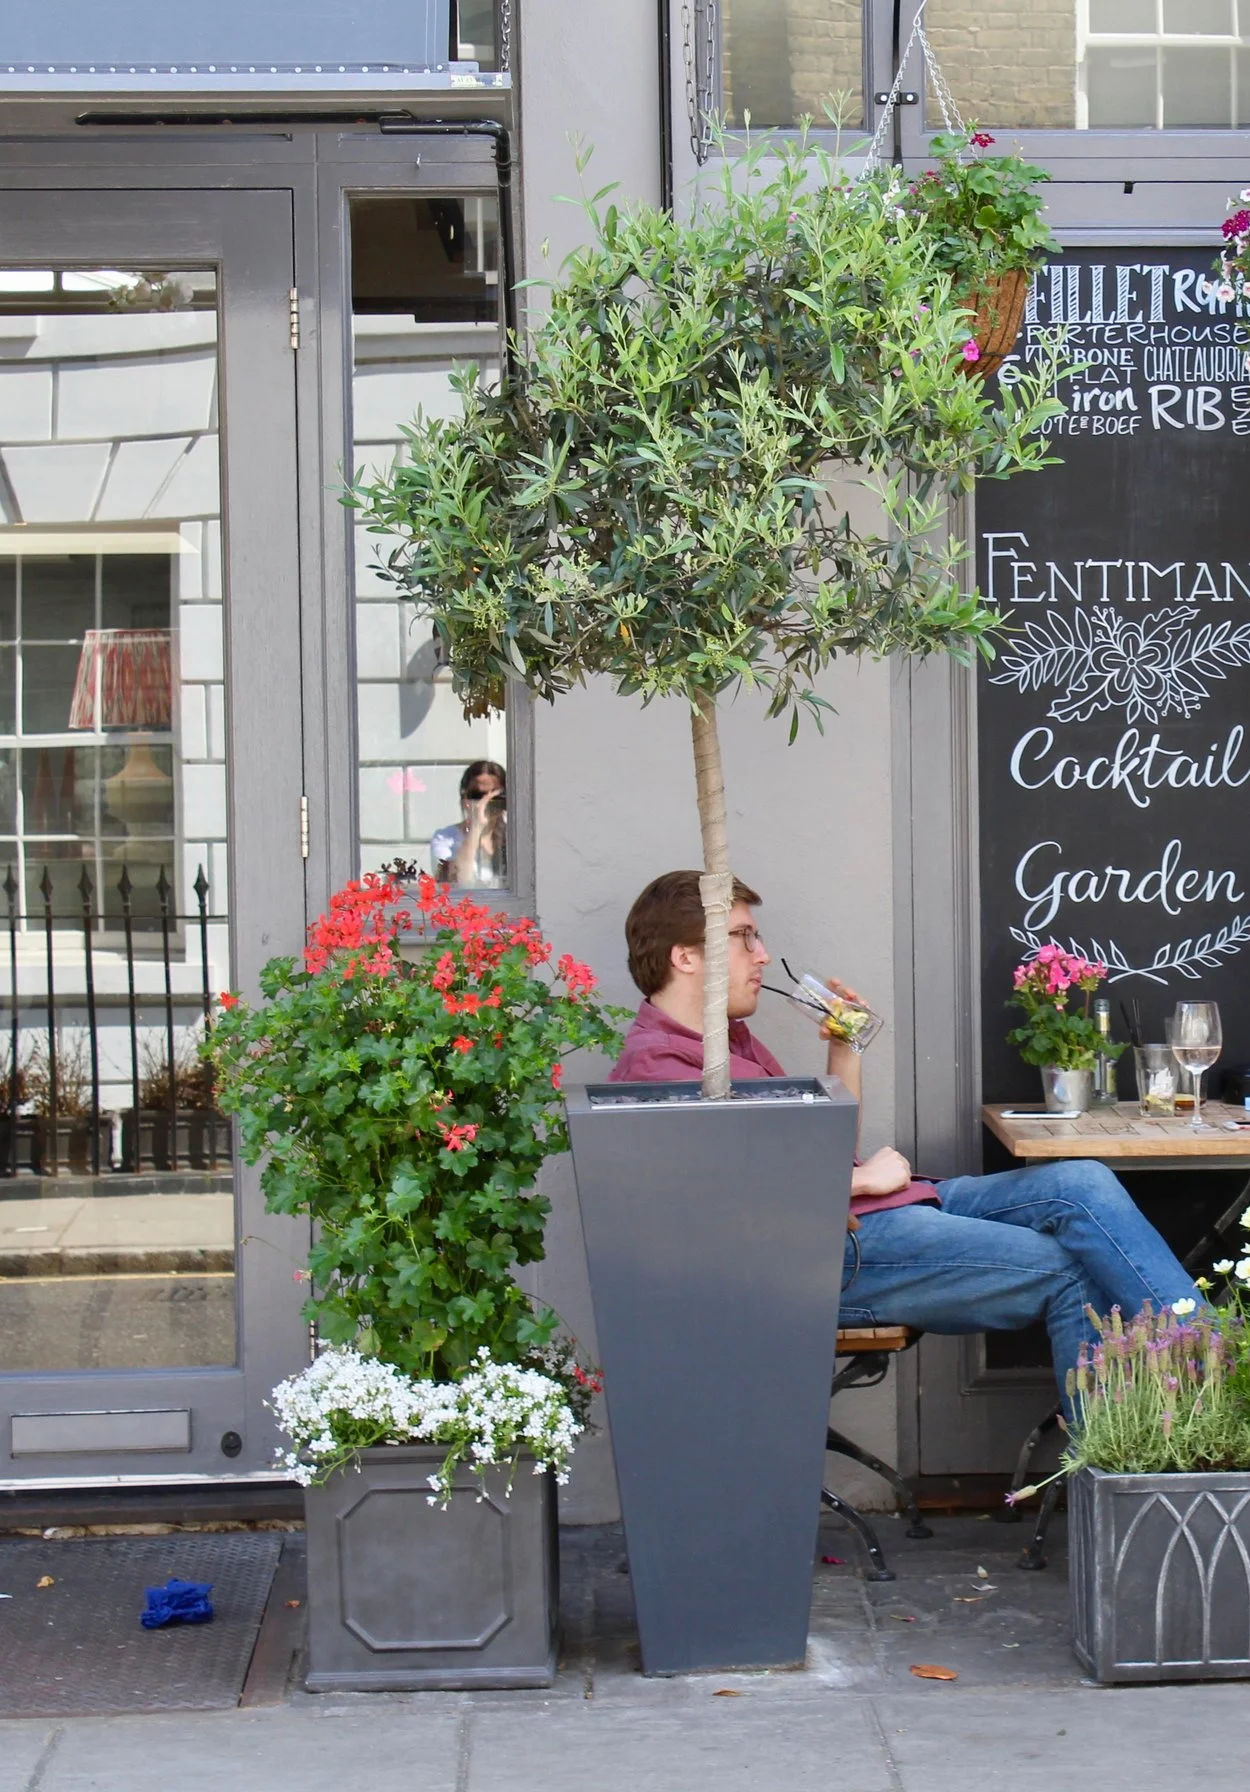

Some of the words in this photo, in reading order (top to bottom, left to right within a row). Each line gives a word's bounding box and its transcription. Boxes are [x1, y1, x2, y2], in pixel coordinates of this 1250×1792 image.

[1024, 264, 1169, 323] FILLET
[1073, 348, 1134, 366] BONE
[1071, 385, 1138, 412] iron
[1147, 384, 1226, 431] RIB
[1030, 411, 1080, 435] OTE
[1091, 415, 1142, 436] BOEF
[1014, 839, 1245, 932] Garden
